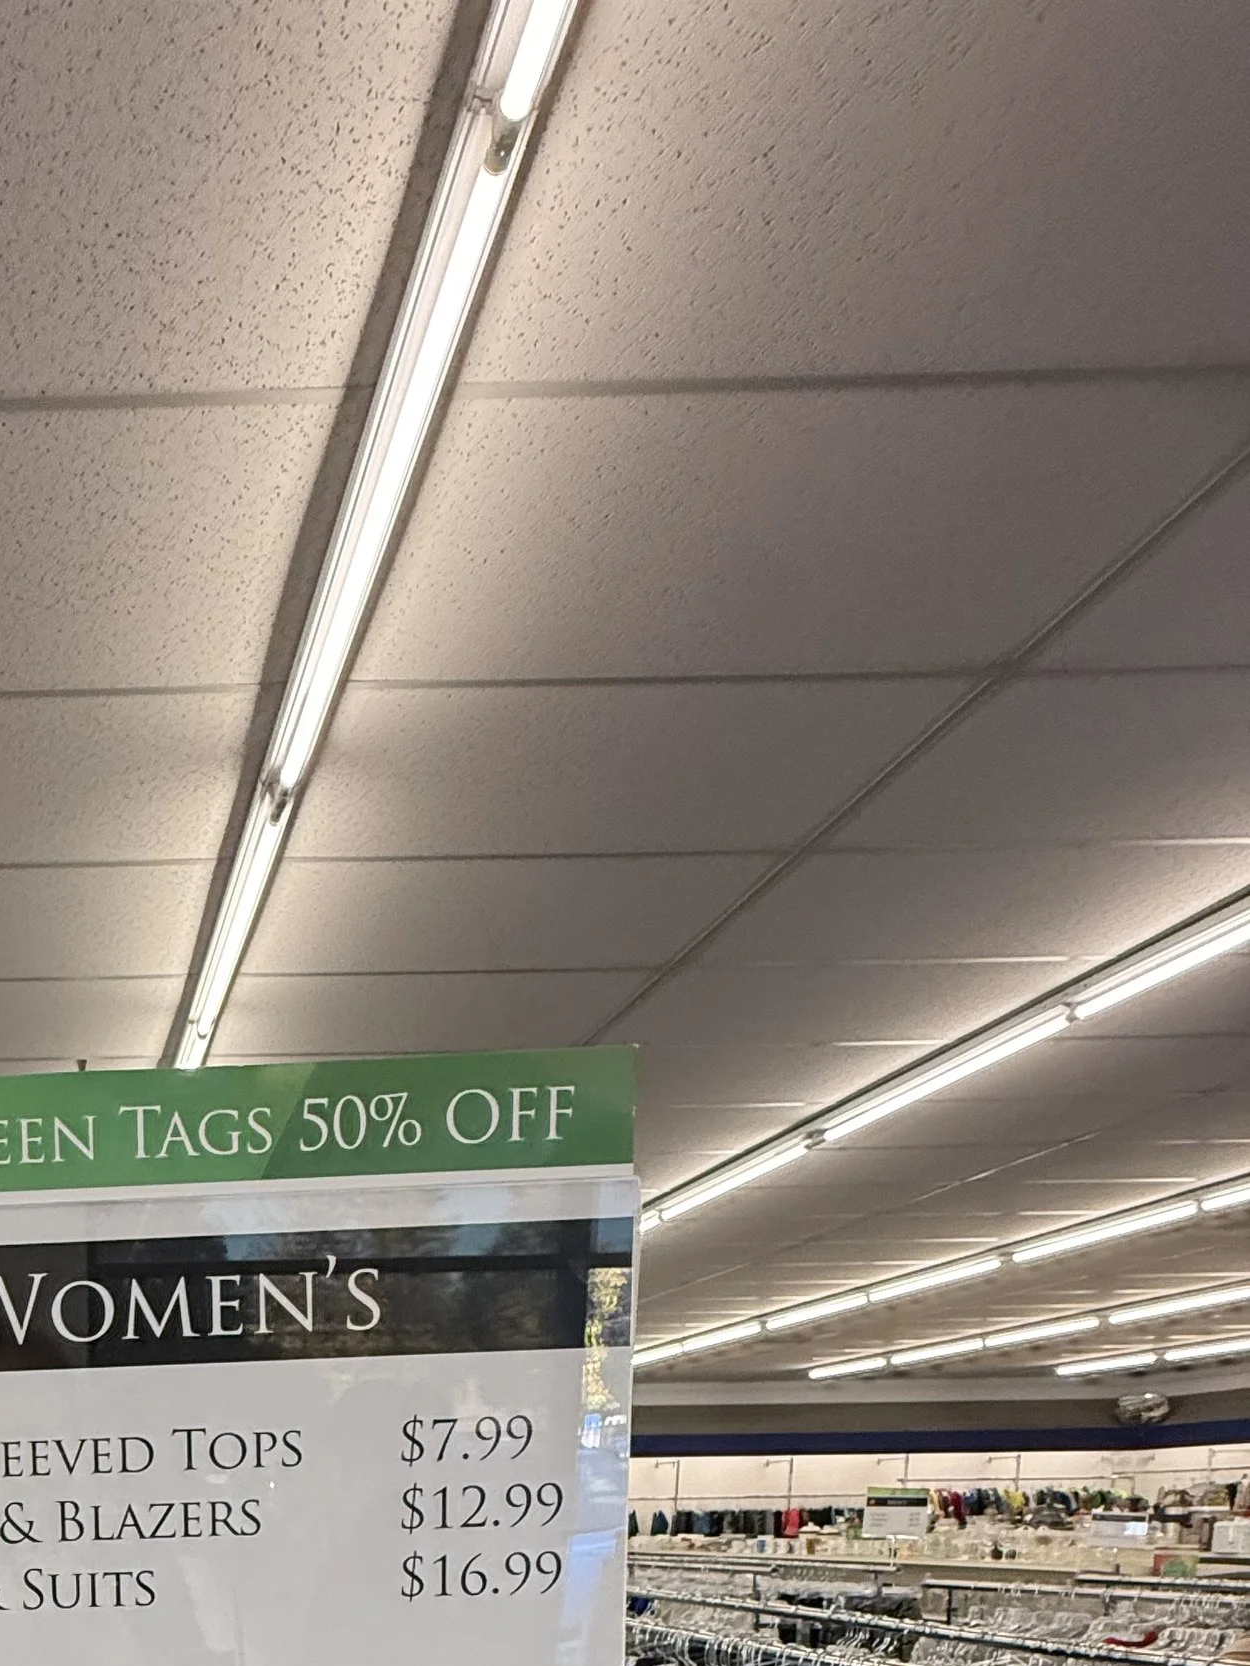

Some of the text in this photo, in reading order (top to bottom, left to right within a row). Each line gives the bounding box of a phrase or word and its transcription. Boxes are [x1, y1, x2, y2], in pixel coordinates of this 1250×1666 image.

[118, 1104, 272, 1159] TAGS
[299, 1092, 422, 1153] 50%
[446, 1085, 575, 1145] OFF
[170, 1427, 303, 1472] TOPS
[401, 1413, 533, 1468] $7.99
[0, 1501, 44, 1545] &
[55, 1499, 262, 1543] BLAZERS
[401, 1482, 564, 1535] $12.99
[22, 1567, 156, 1611] SUITS
[401, 1550, 562, 1603] $16.99
